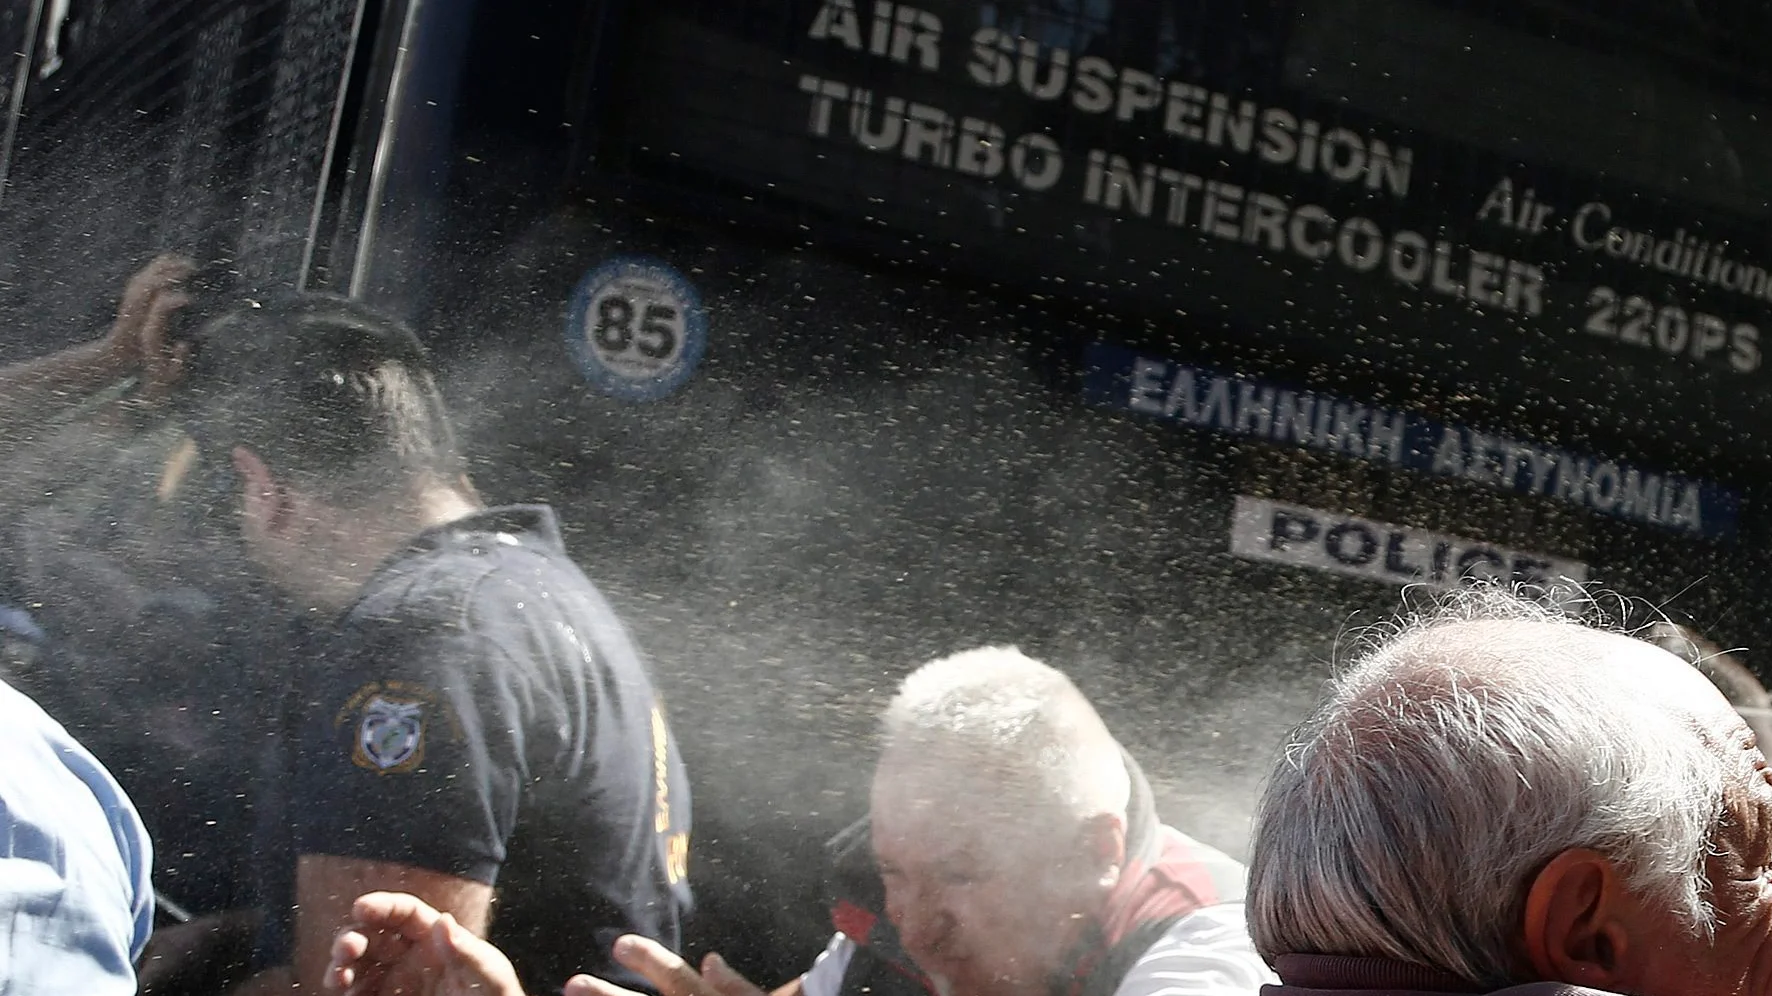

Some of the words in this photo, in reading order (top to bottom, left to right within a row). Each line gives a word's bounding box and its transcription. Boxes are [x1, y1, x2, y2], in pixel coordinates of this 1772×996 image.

[807, 0, 944, 72] AIR
[966, 26, 1413, 199] SUSPENSION
[798, 74, 1064, 193] TURBO
[1082, 148, 1545, 318] INTERCOOLER
[1584, 285, 1763, 374] 220PS
[1476, 176, 1557, 235] Air
[594, 295, 676, 359] 85
